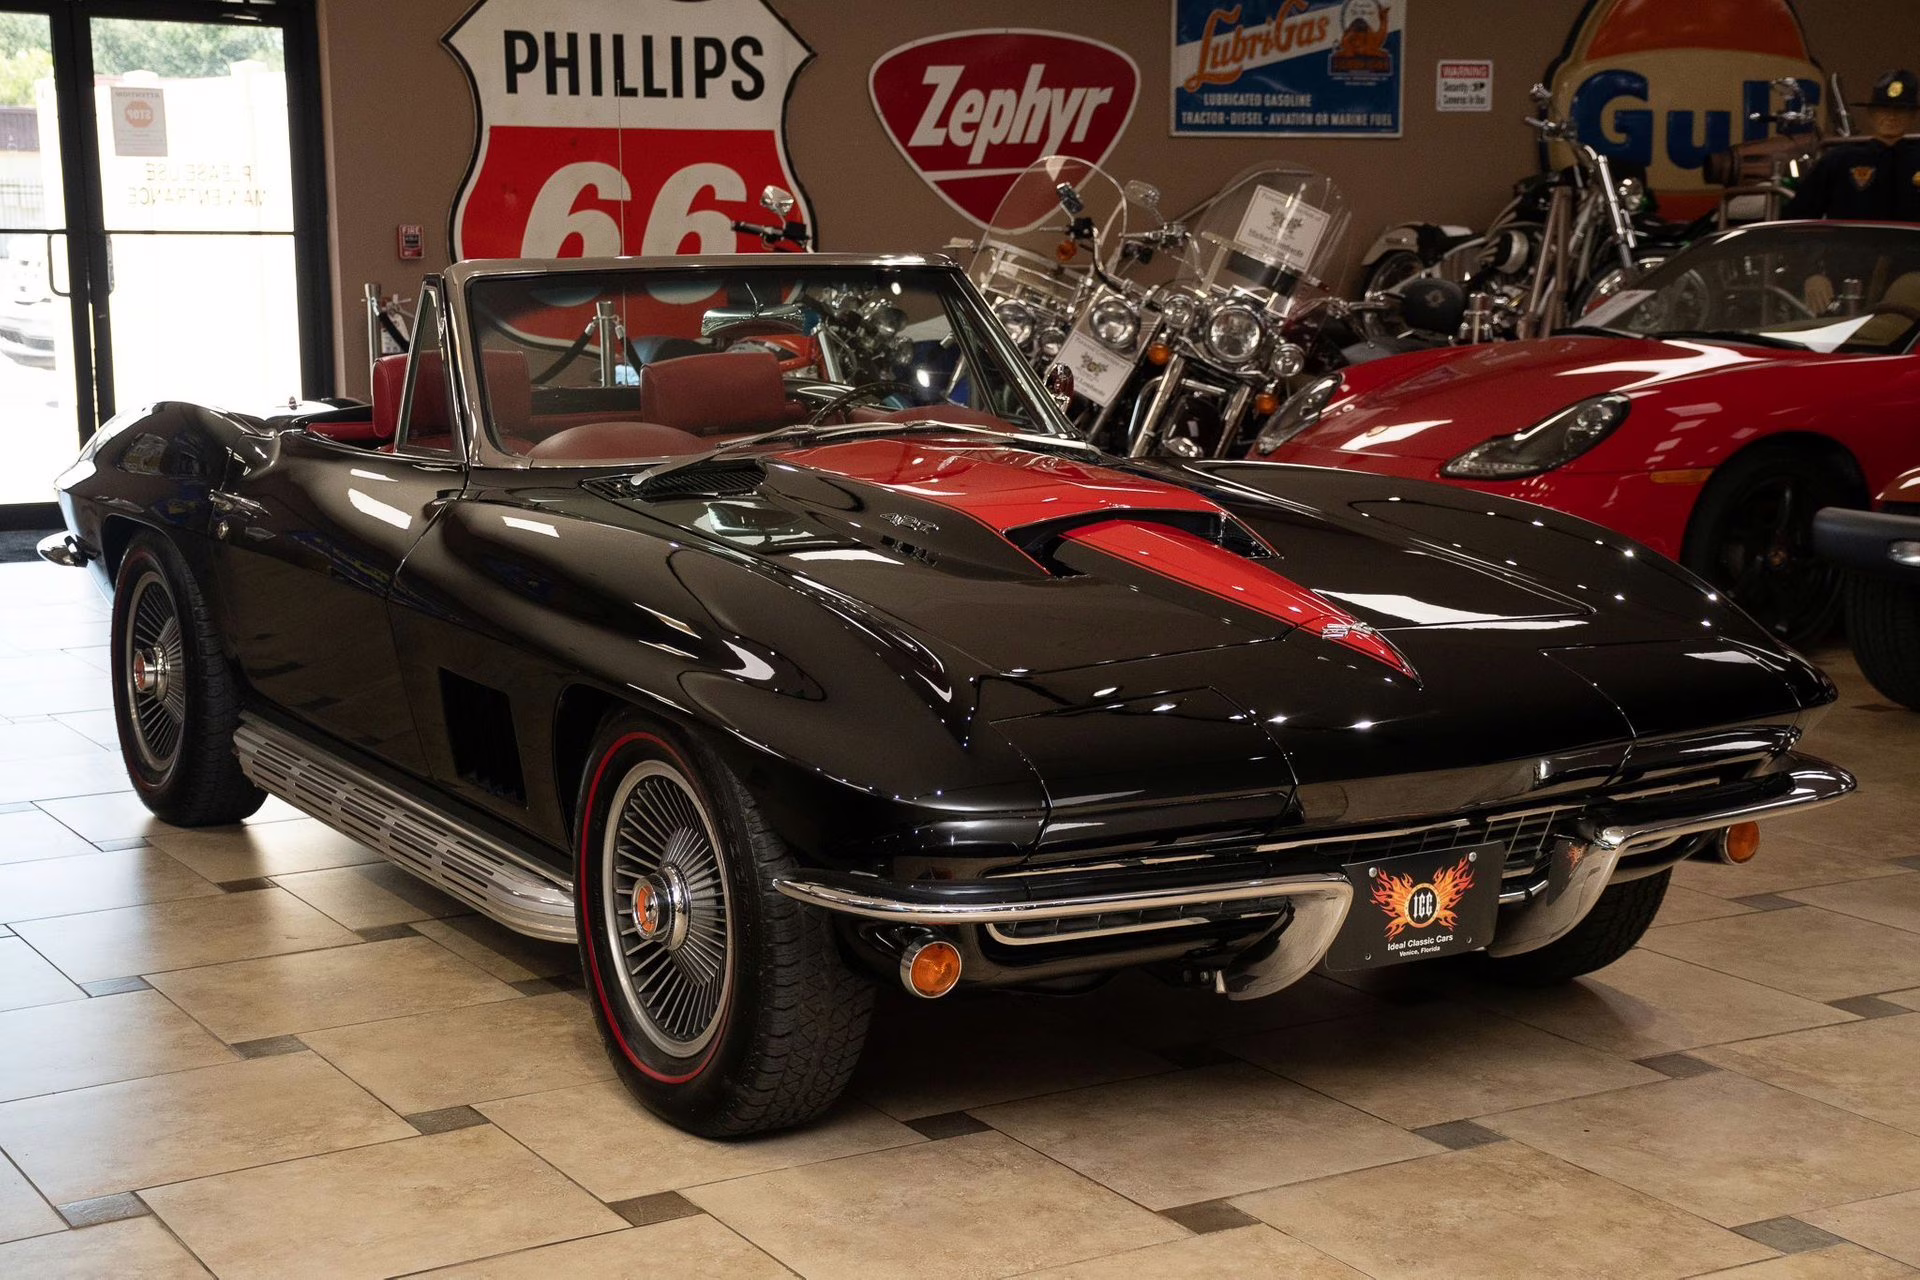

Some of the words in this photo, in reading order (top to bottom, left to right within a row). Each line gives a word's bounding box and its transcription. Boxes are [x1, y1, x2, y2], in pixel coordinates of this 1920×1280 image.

[504, 30, 765, 101] PHILLIPS
[1442, 66, 1488, 77] WARNING
[1203, 93, 1262, 107] LUBRICATED
[1264, 94, 1312, 107] GASOLINE
[907, 64, 1114, 164] Zephyr
[1182, 111, 1225, 125] TRACTOR
[1230, 112, 1263, 125] DIESEL
[1268, 112, 1313, 126] AVIATION
[1315, 113, 1329, 126] OR
[1331, 113, 1367, 126] MARINE
[1369, 113, 1393, 126] FUEL
[402, 226, 420, 234] FIRE
[520, 161, 747, 304] 66
[880, 512, 940, 534] 427
[1413, 891, 1433, 920] ICC
[1387, 941, 1406, 951] Ideal
[1407, 936, 1434, 948] Classic
[1436, 934, 1454, 944] Cars
[1399, 948, 1420, 957] Venice,
[1420, 945, 1441, 954] Florida
